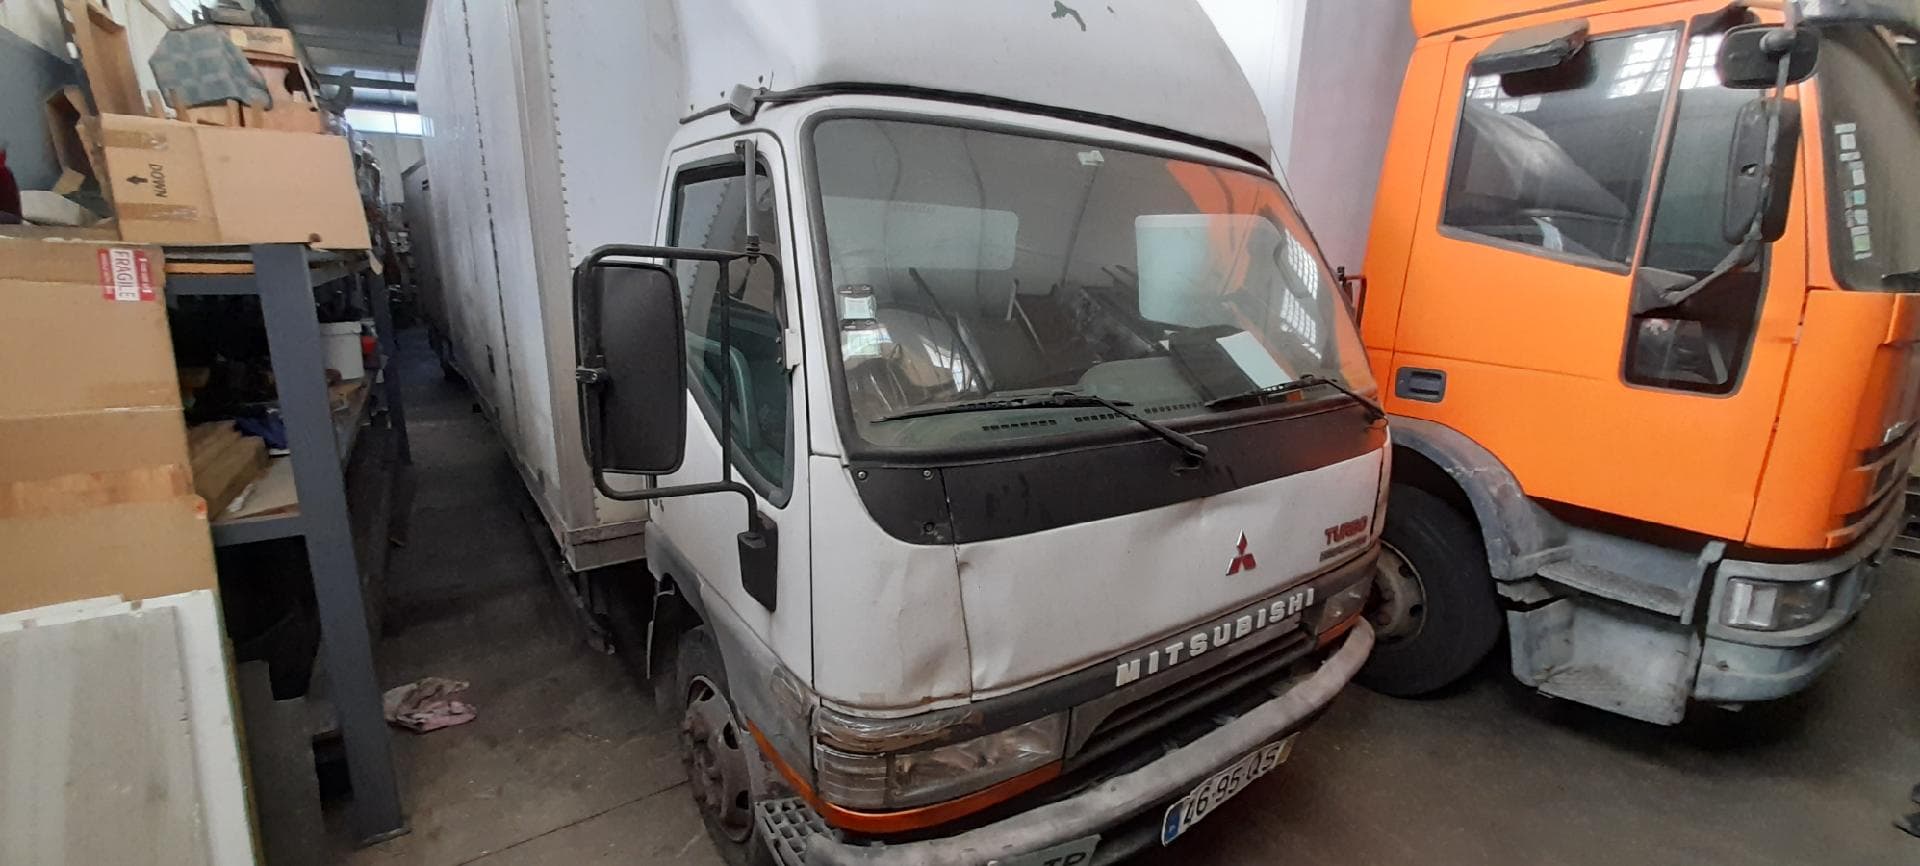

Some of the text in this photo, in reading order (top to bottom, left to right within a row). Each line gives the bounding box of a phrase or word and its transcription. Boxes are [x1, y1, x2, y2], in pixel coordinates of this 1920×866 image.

[148, 163, 168, 198] DOWN
[113, 250, 137, 298] FRAGILE
[1324, 515, 1369, 546] TURBO
[1115, 587, 1315, 687] MITSUBISHI
